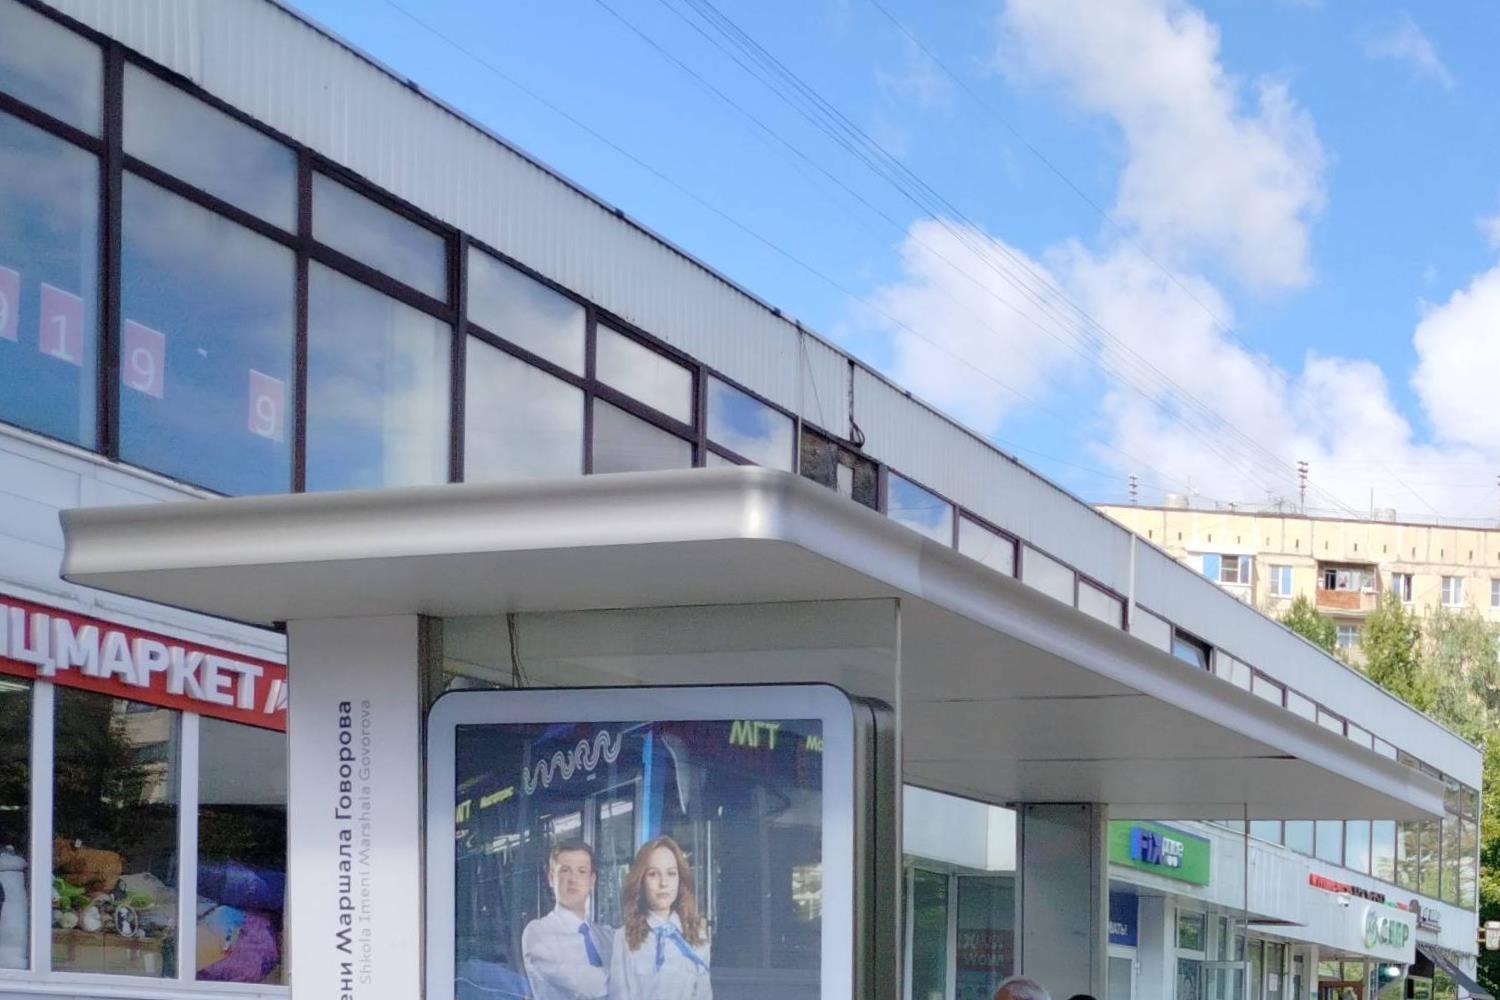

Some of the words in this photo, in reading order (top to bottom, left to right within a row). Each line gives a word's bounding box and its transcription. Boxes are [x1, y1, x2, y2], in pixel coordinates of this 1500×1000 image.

[335, 701, 355, 820] Говорова
[358, 700, 371, 781] Govorova
[729, 720, 779, 749] МГТ
[358, 786, 371, 866] Marshala
[336, 828, 355, 954] Маршала
[358, 871, 371, 922] Imeni
[358, 927, 372, 985] Shkola
